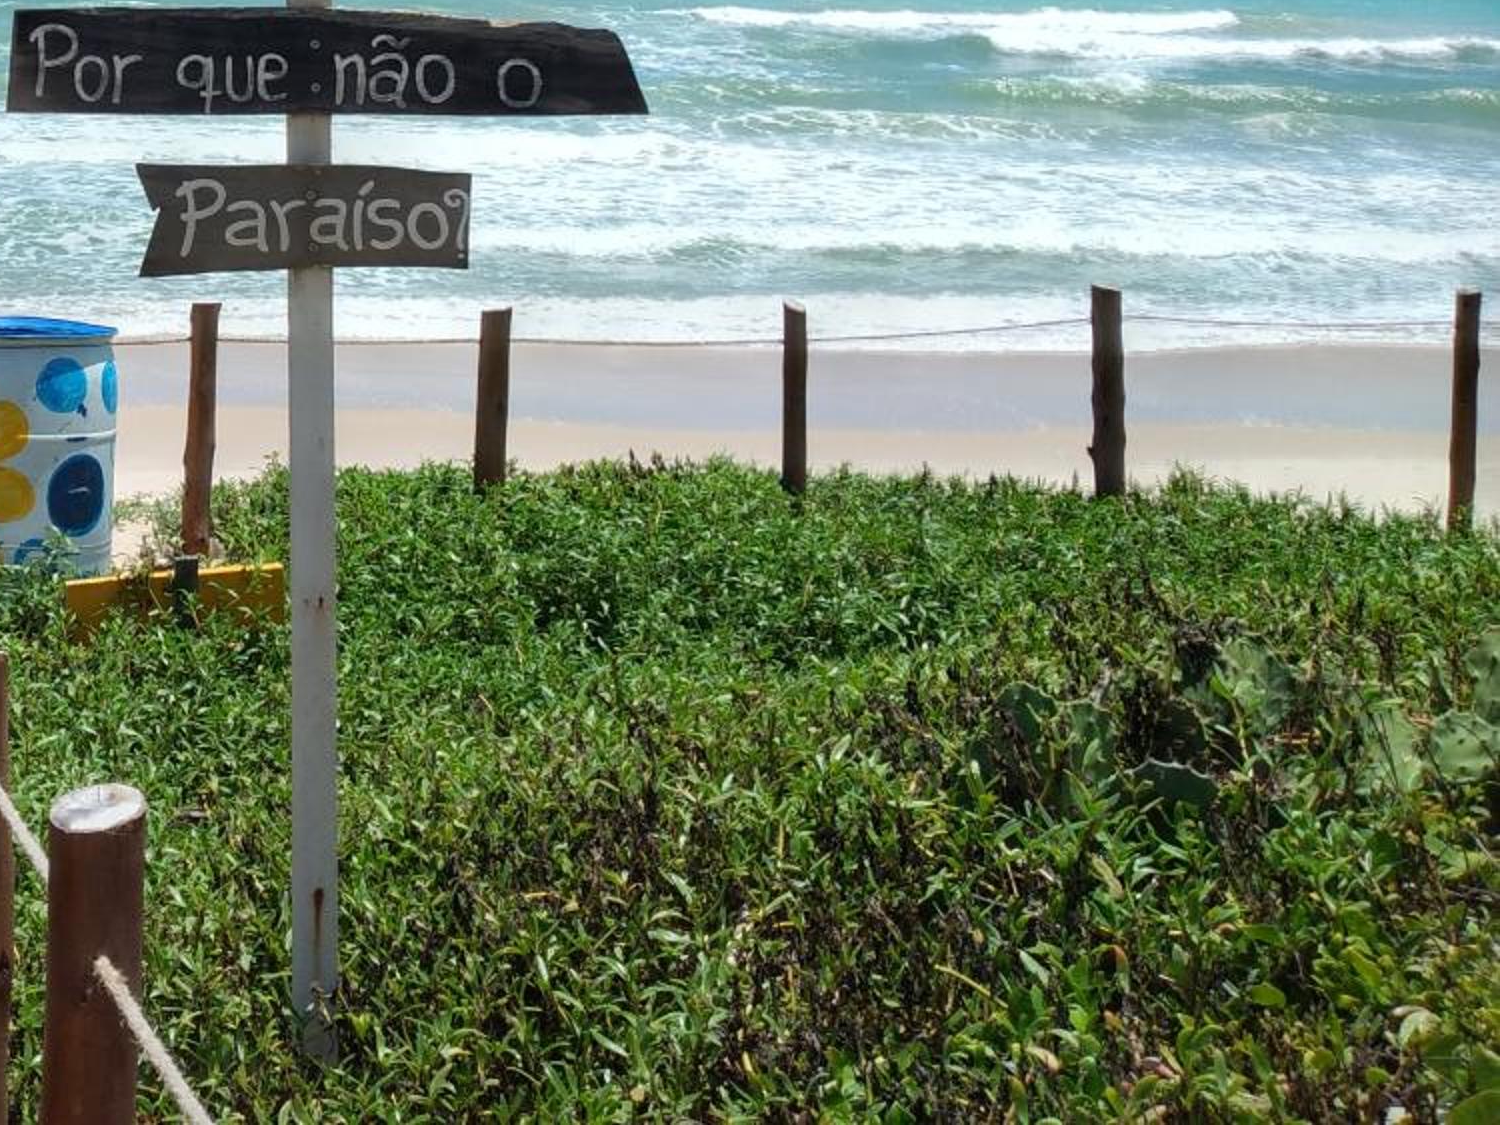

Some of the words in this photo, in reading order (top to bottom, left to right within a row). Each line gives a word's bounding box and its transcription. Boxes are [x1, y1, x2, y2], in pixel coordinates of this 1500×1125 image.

[29, 23, 143, 104] Por
[176, 52, 289, 113] que
[333, 33, 455, 108] não
[498, 57, 543, 108] o
[175, 178, 469, 260] Paraíso?
